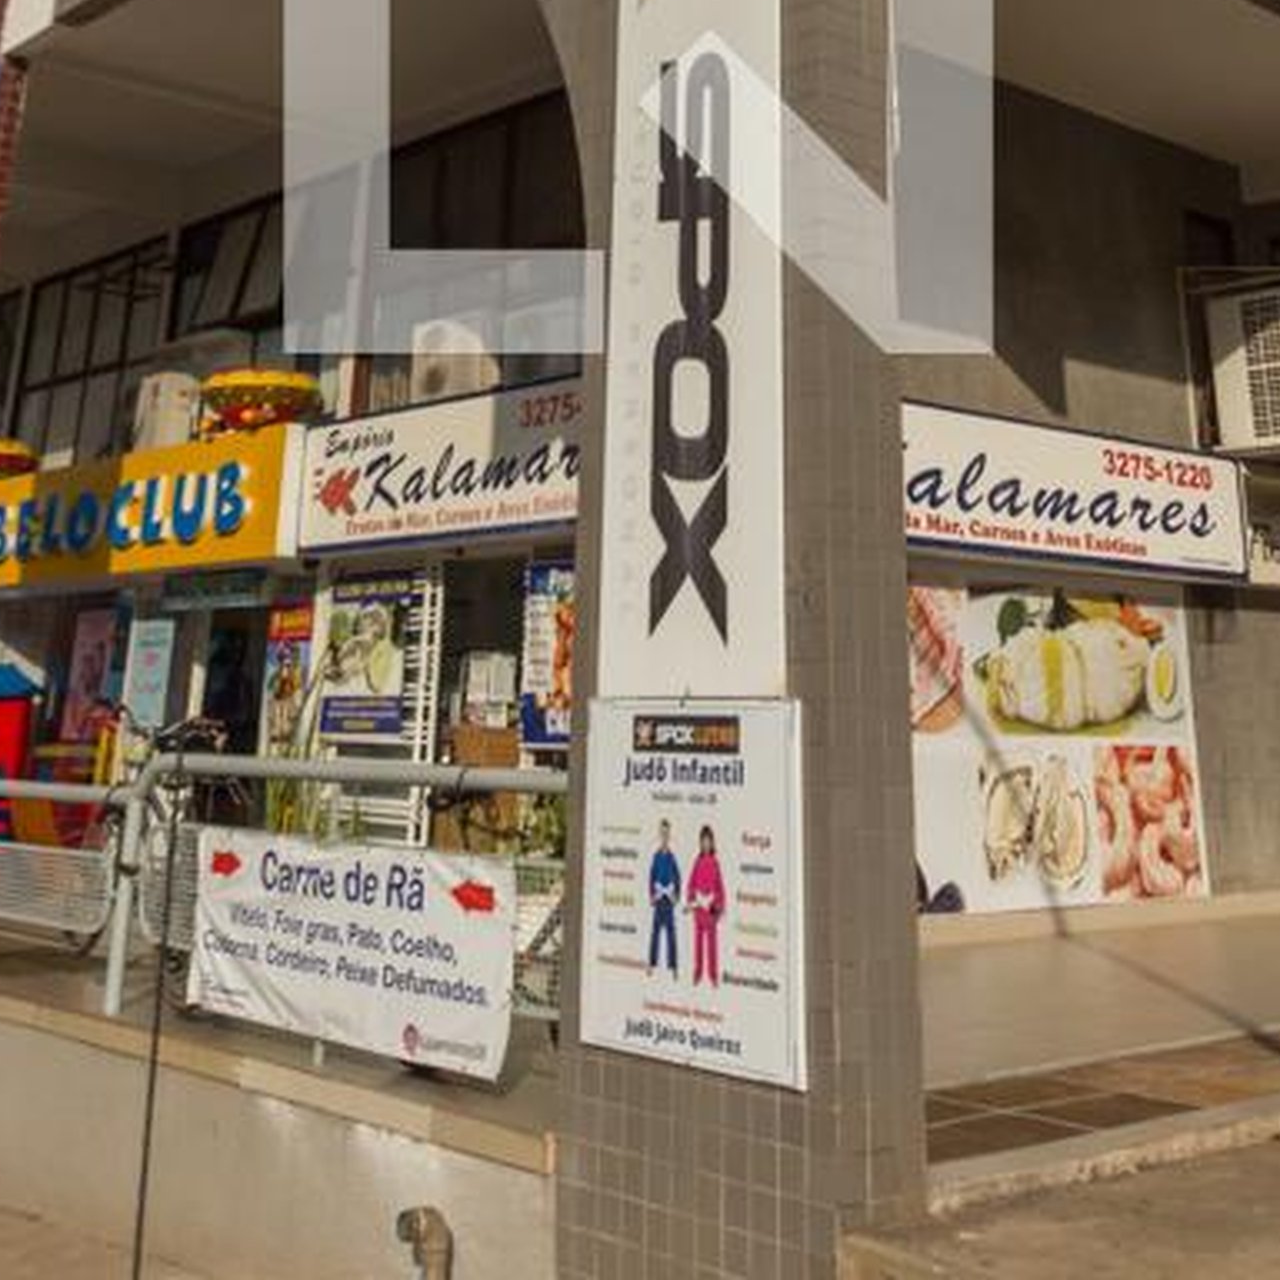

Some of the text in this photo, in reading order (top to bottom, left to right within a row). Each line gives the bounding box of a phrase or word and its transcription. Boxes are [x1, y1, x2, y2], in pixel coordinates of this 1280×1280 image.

[364, 442, 581, 512] Kalamar
[1102, 447, 1214, 492] 3275-1220
[906, 453, 1218, 538] alamares
[969, 521, 1027, 545] Carnes
[623, 756, 746, 788] Judô Infantil
[259, 848, 426, 912] Carne de Rã
[389, 928, 459, 968] Coelho,
